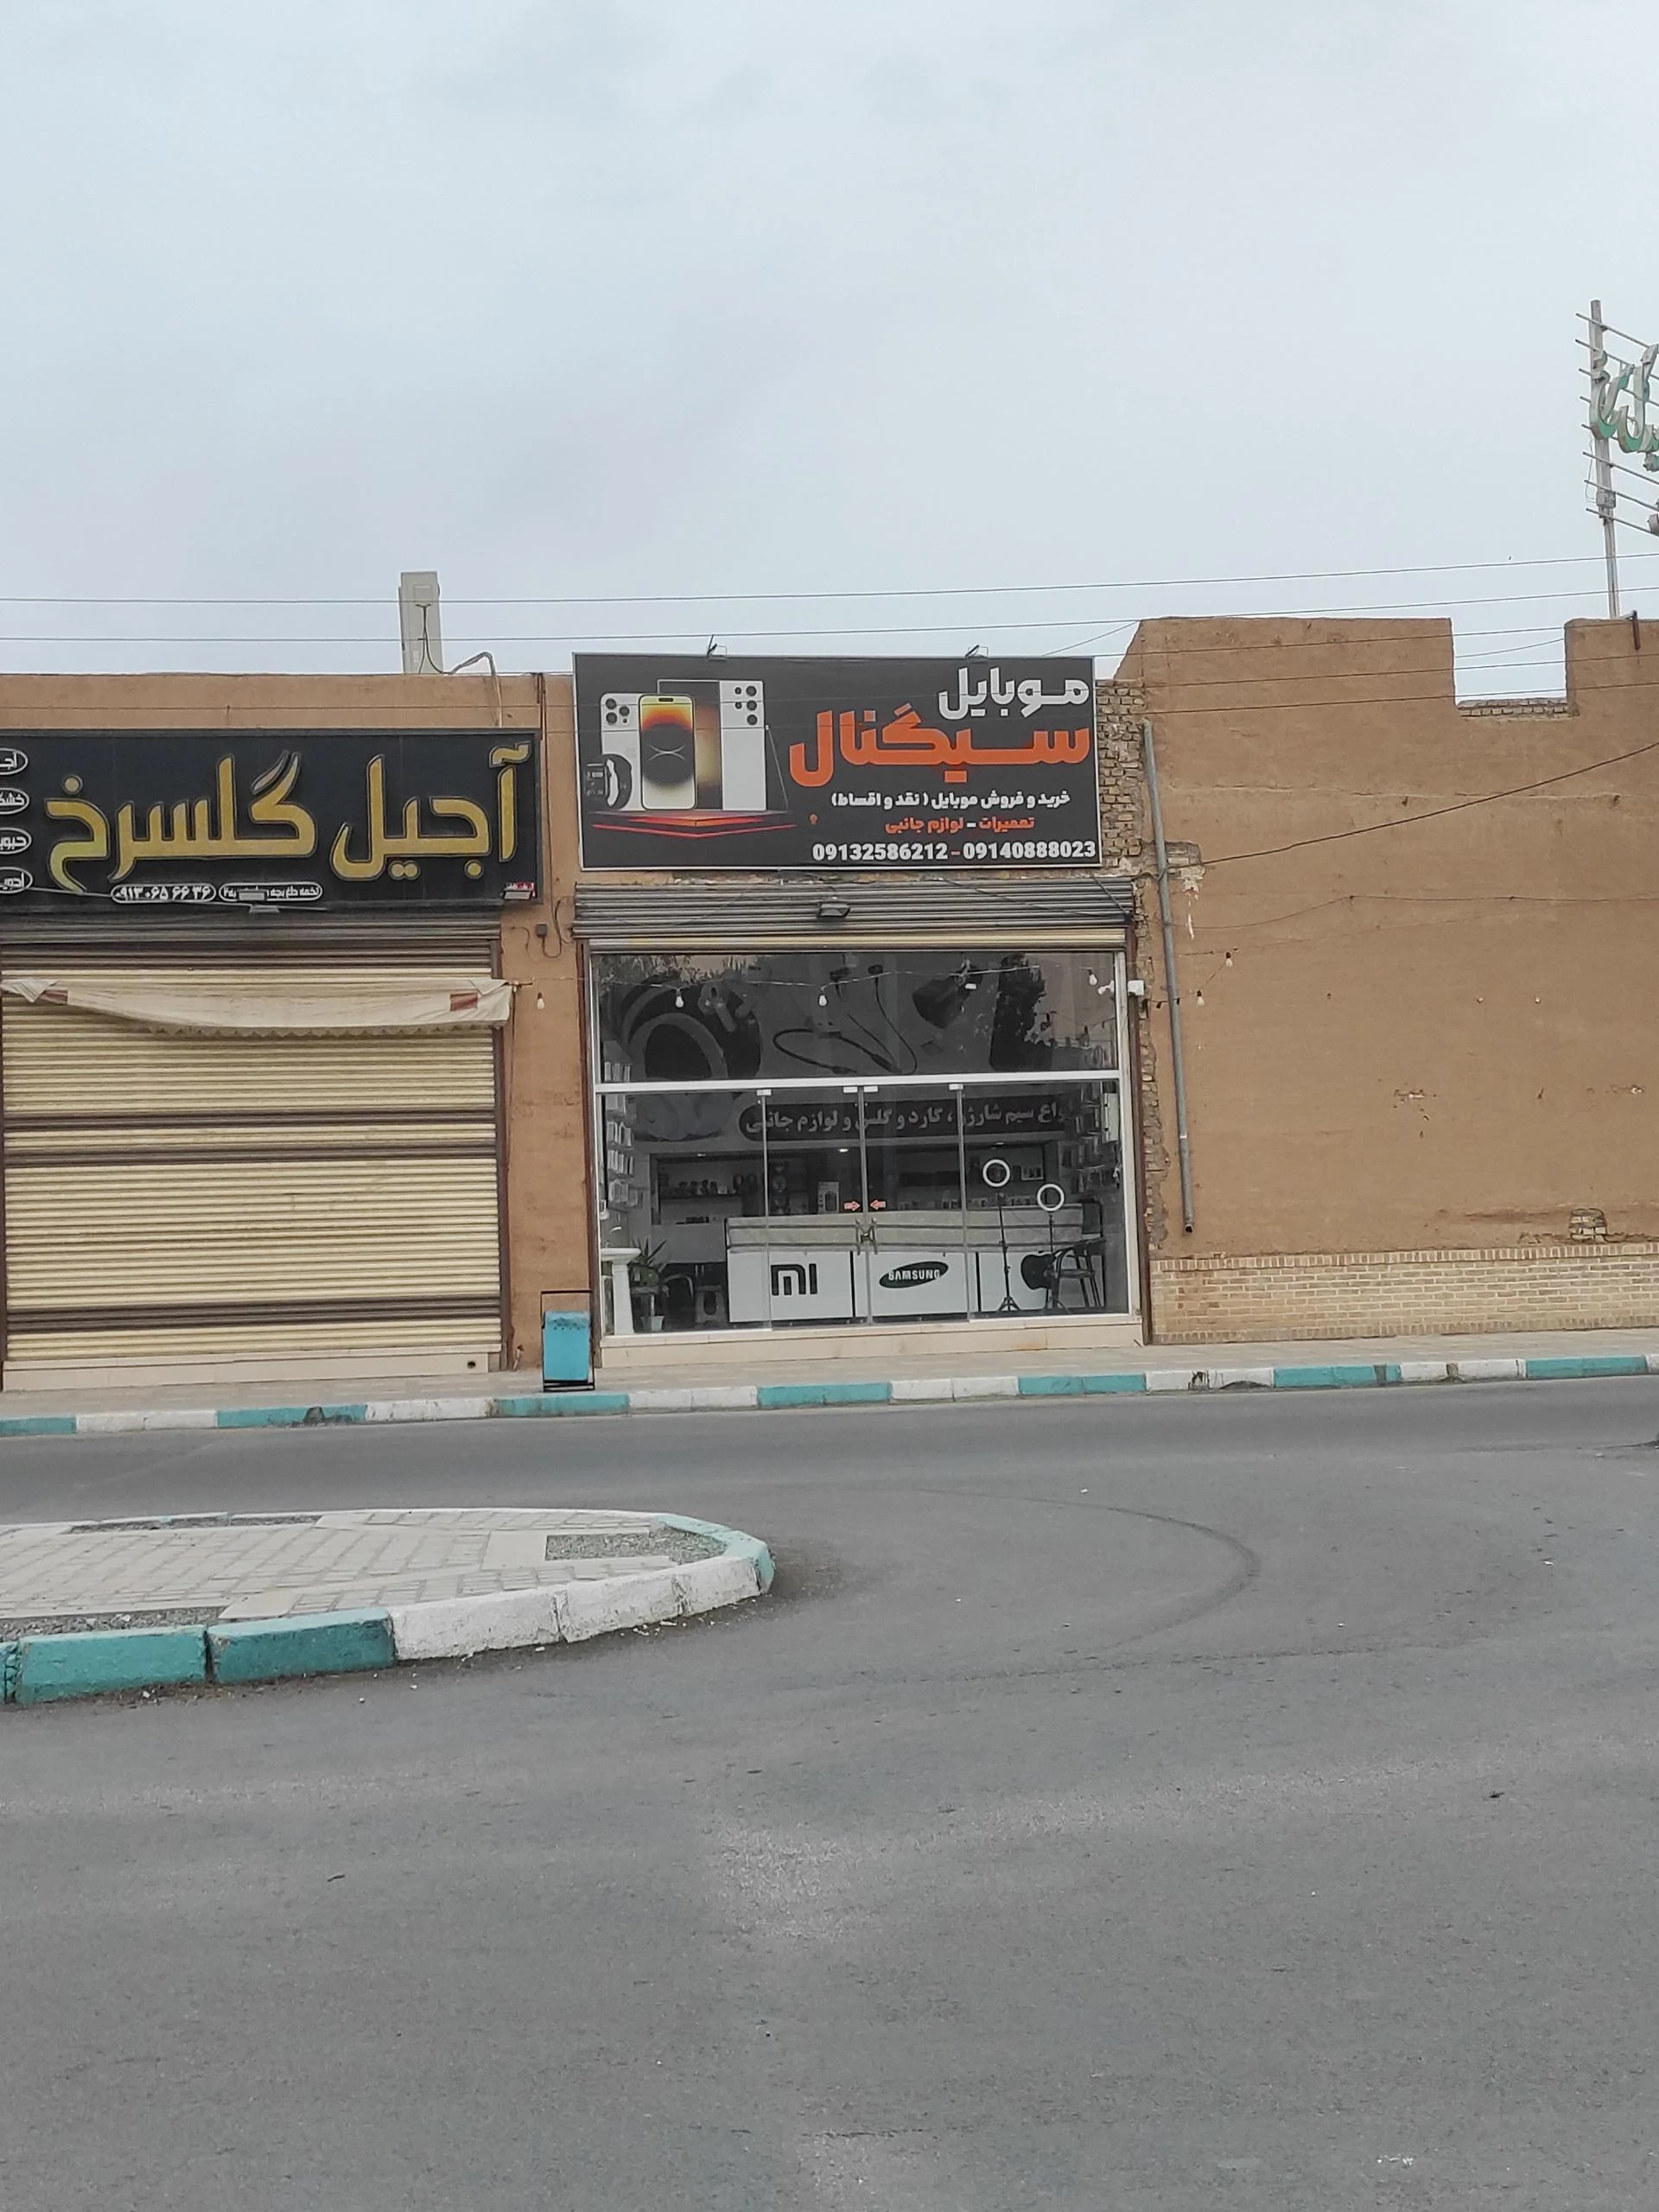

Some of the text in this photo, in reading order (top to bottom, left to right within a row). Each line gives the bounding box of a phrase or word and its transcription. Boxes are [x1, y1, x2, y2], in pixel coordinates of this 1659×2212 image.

[939, 666, 1090, 721] موبایل
[790, 703, 1090, 787] سیگنال
[883, 795, 893, 810] و
[931, 791, 978, 809] موبایل
[981, 790, 1024, 809] فروش
[1027, 794, 1036, 809] و
[1038, 790, 1071, 808] خرید
[43, 741, 531, 893] آجیل گلسرخ
[885, 816, 925, 834] جانبی
[927, 816, 964, 834] لوازم
[978, 816, 1036, 833] تعمیرات
[811, 841, 949, 861] 09132586212
[963, 840, 1096, 859] 09140888023
[797, 1109, 838, 1133] لوازم
[888, 1268, 940, 1281] SAMSUNG
